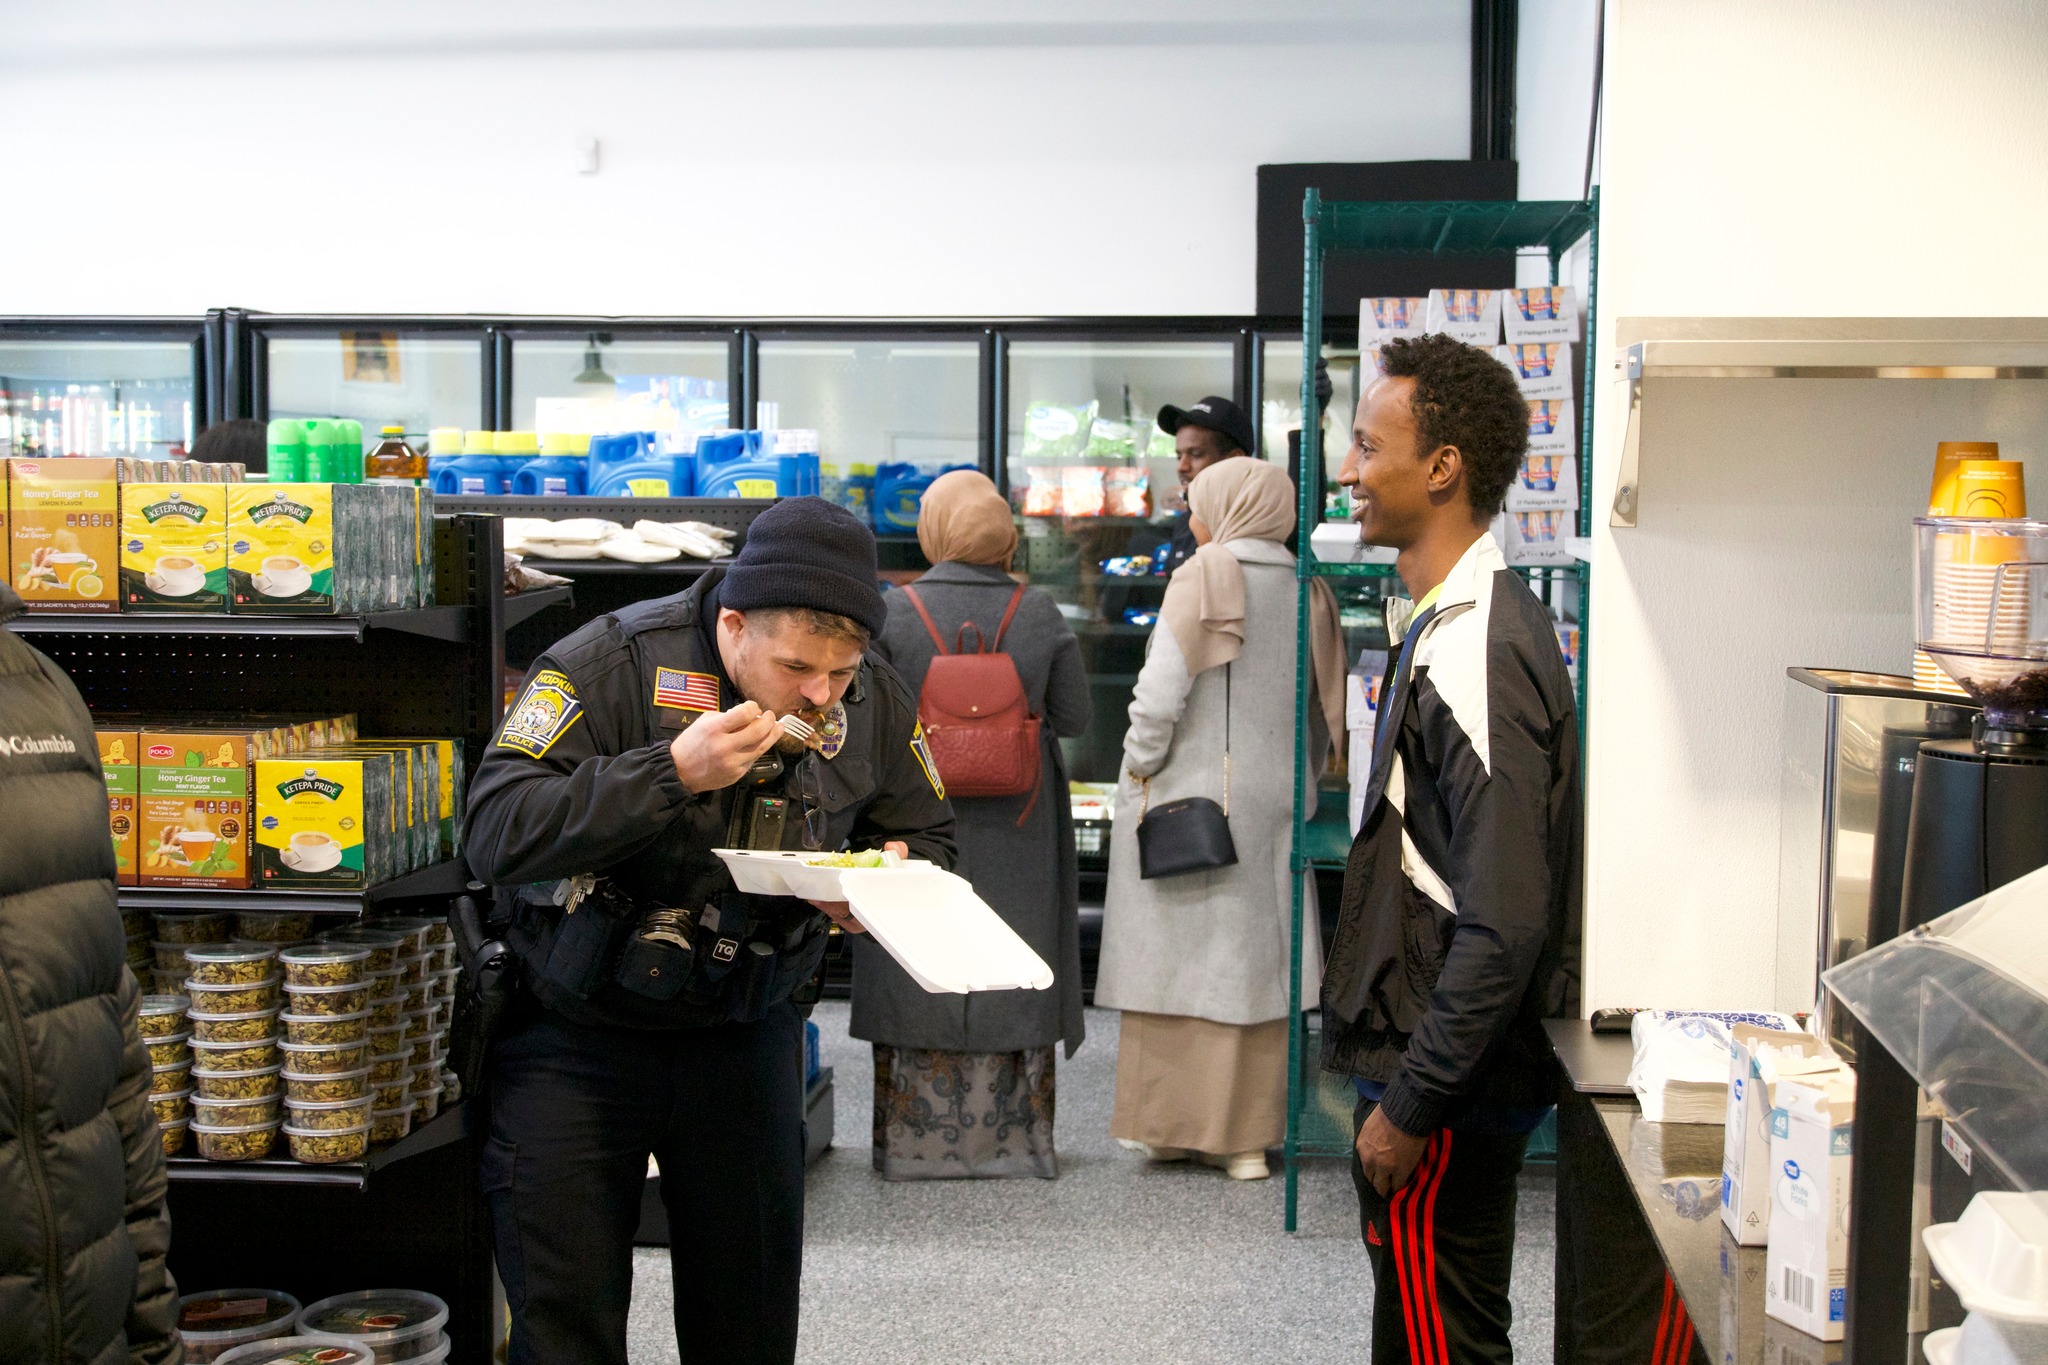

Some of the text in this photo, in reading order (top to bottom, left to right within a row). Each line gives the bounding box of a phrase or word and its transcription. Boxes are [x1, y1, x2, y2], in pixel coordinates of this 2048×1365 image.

[22, 489, 99, 499] Honey Ginger Tea
[149, 504, 201, 518] KETEPA PRIDE
[256, 505, 307, 519] KETEPA PRIDE
[30, 531, 53, 540] Ginger
[9, 734, 76, 755] Columbia
[505, 735, 537, 749] POLICE
[158, 774, 226, 784] Honey Ginger Tea
[284, 781, 338, 796] KETEPA PRIDE
[718, 943, 734, 956] TQ
[1774, 1115, 1786, 1130] 48
[1834, 1133, 1850, 1147] 48
[1791, 1183, 1809, 1197] White
[1790, 1192, 1808, 1208] Forks
